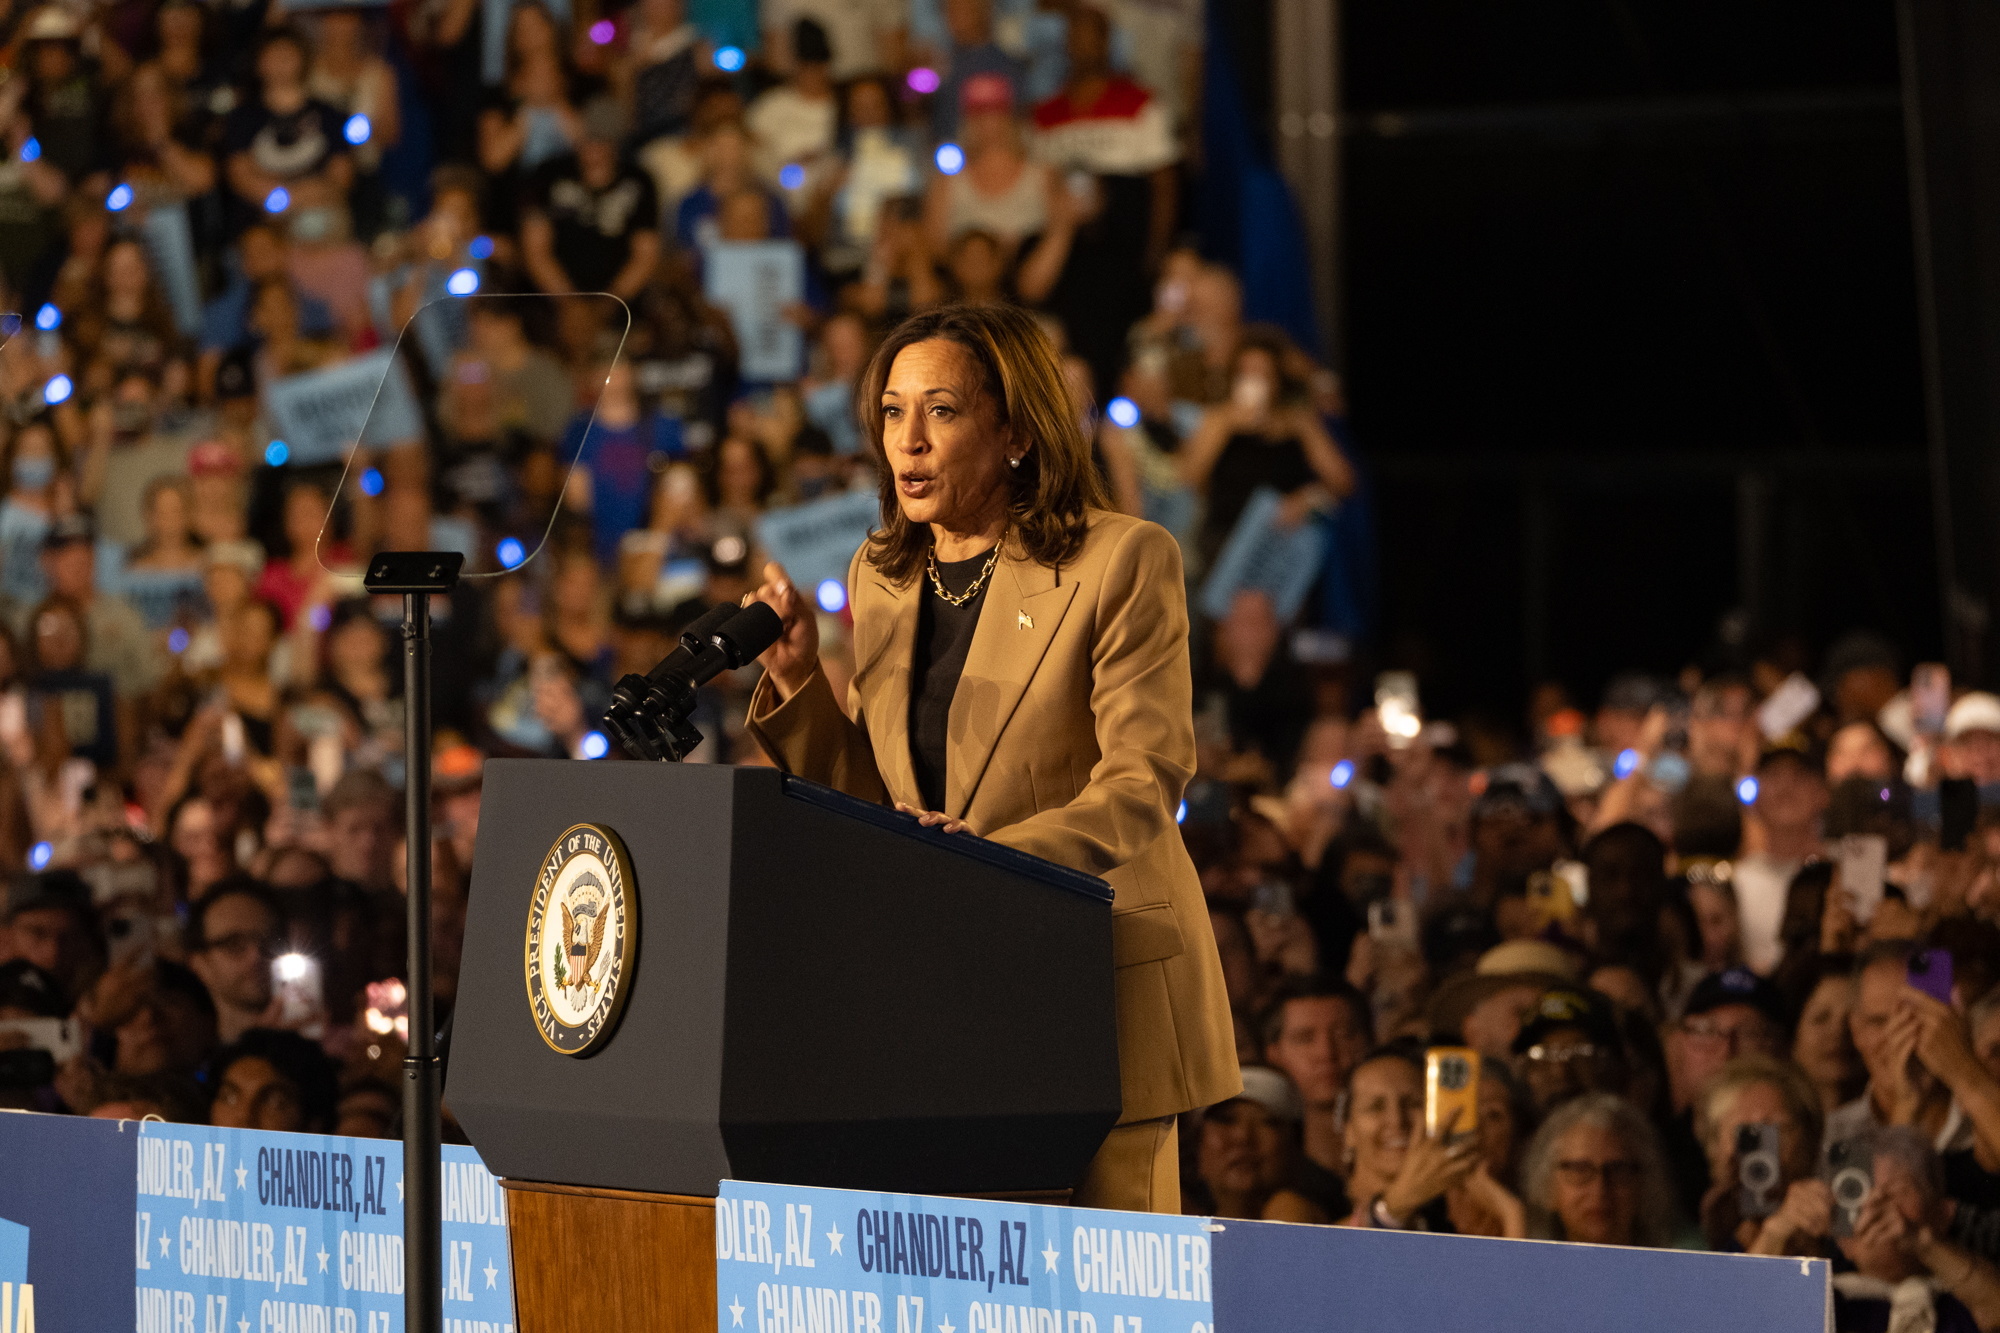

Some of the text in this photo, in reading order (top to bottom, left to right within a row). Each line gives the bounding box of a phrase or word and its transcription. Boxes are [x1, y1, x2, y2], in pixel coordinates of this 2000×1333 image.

[529, 834, 625, 1041] VICE PRESIDENT OF THE UNITED STATES
[203, 1143, 225, 1202] AZ
[258, 1146, 361, 1223] CHANDLER,
[364, 1155, 387, 1215] AZ
[180, 1216, 282, 1293] CHANDLER,
[284, 1226, 308, 1286] AZ
[716, 1197, 1211, 1302] DLER, AZ CHANDLER, AZ CHANDLER
